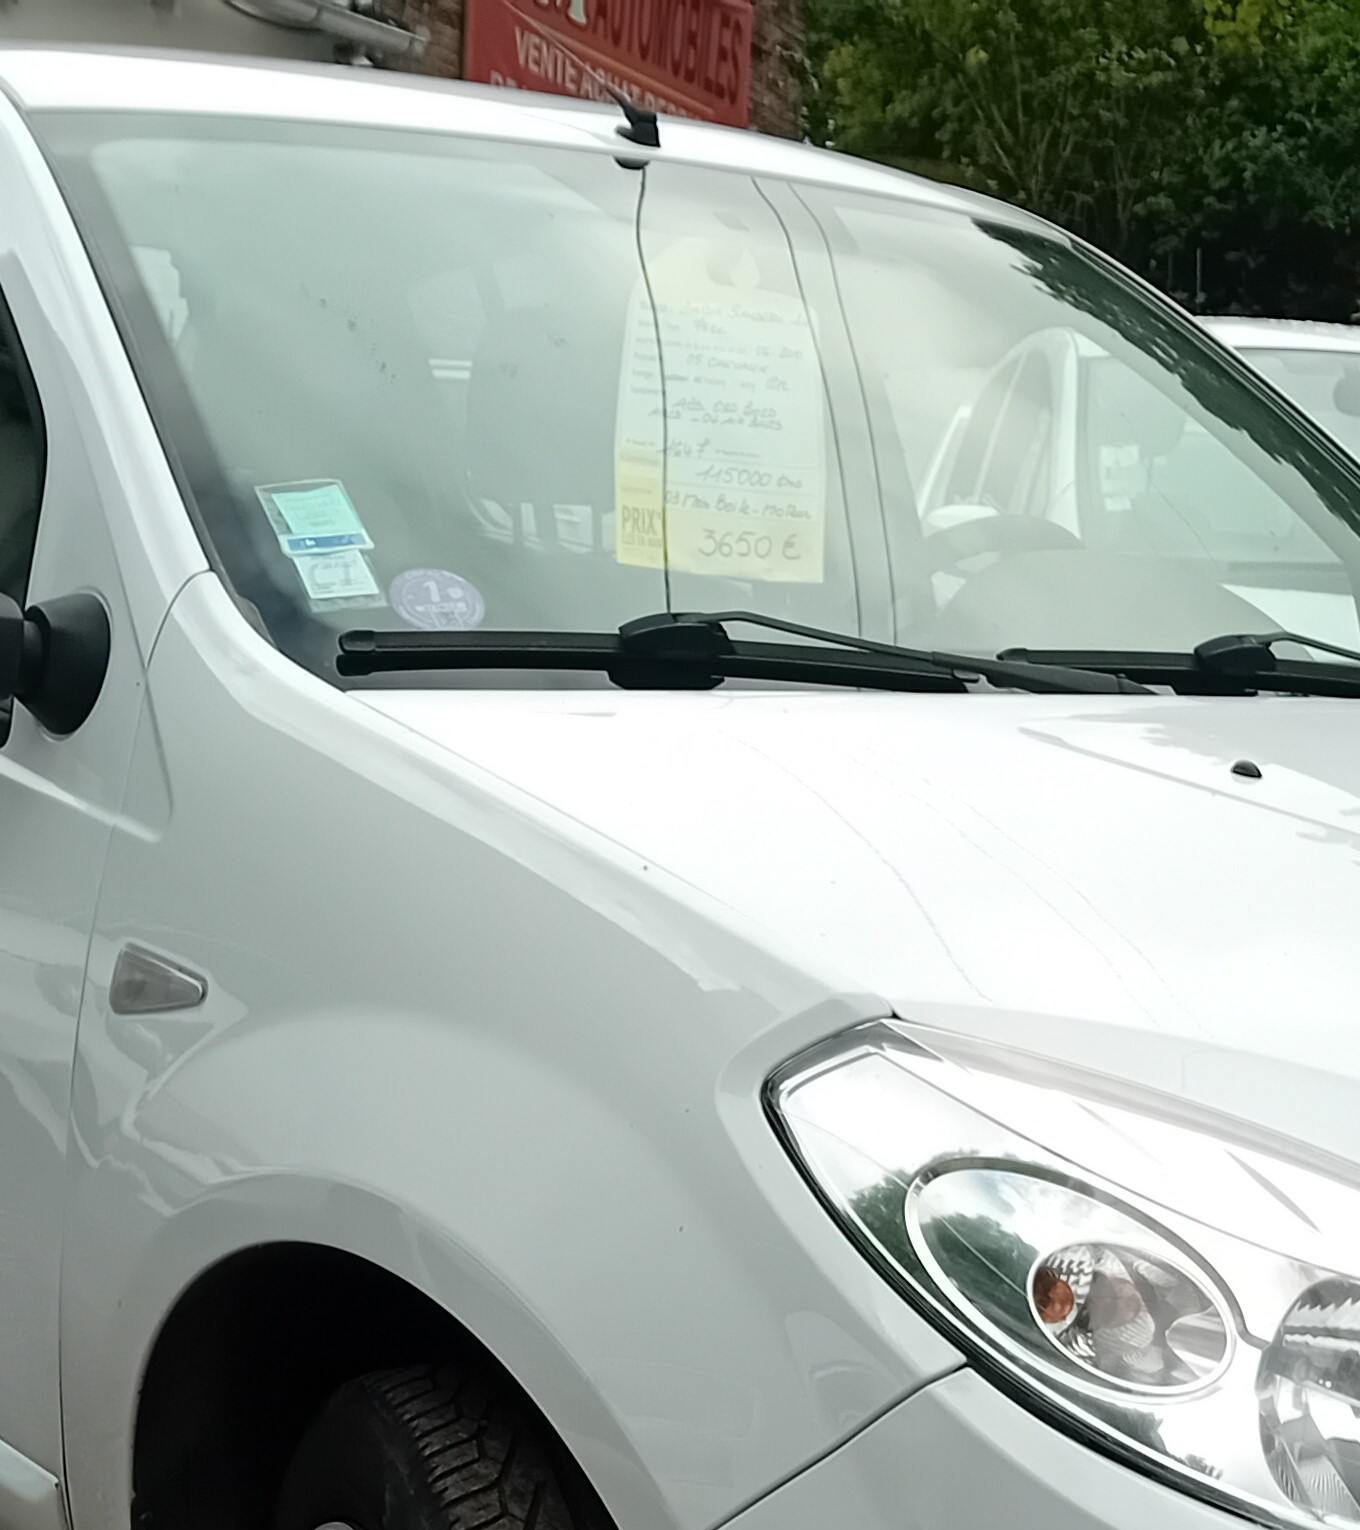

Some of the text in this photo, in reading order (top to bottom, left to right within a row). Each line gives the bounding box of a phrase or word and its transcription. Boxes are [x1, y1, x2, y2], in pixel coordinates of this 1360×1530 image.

[514, 26, 578, 92] VENTE
[695, 464, 773, 488] 115000
[697, 527, 773, 559] 3650
